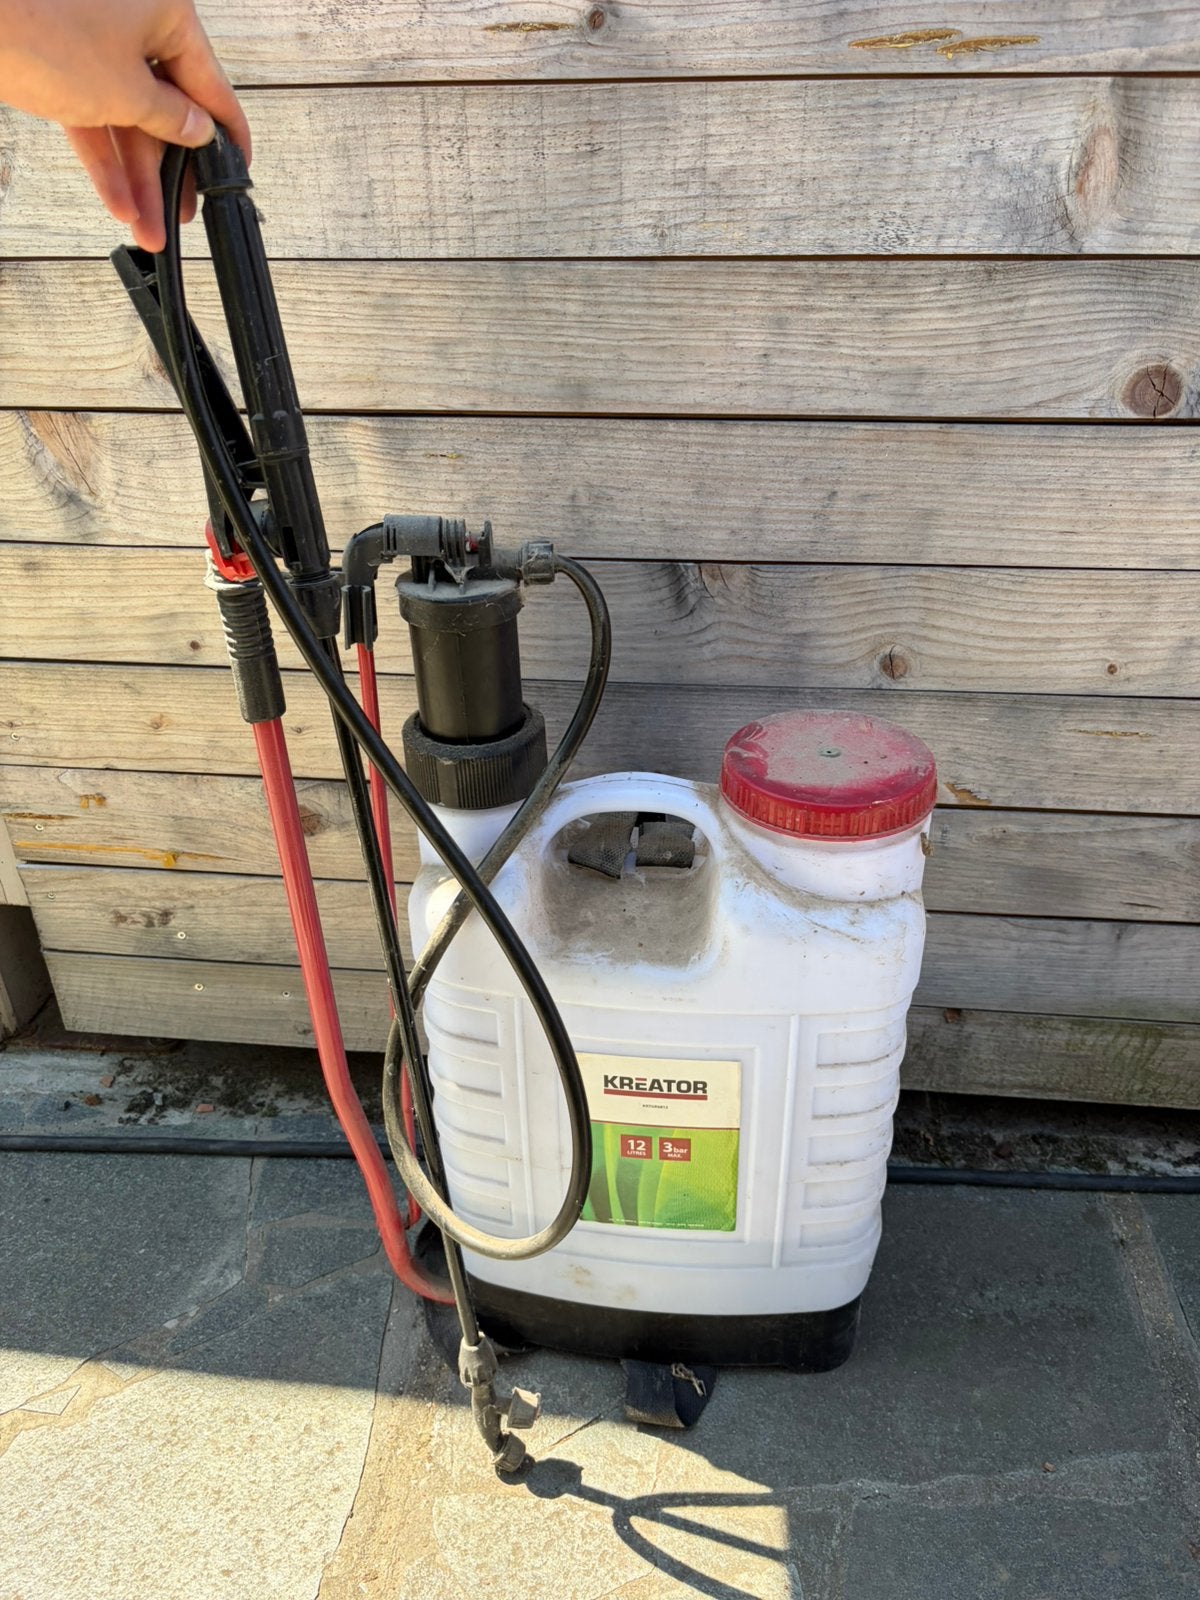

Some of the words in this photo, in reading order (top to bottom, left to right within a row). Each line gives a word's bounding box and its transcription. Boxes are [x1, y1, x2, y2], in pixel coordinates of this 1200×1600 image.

[603, 1074, 708, 1094] KREATOR
[627, 1139, 646, 1151] 12
[662, 1141, 673, 1153] 3
